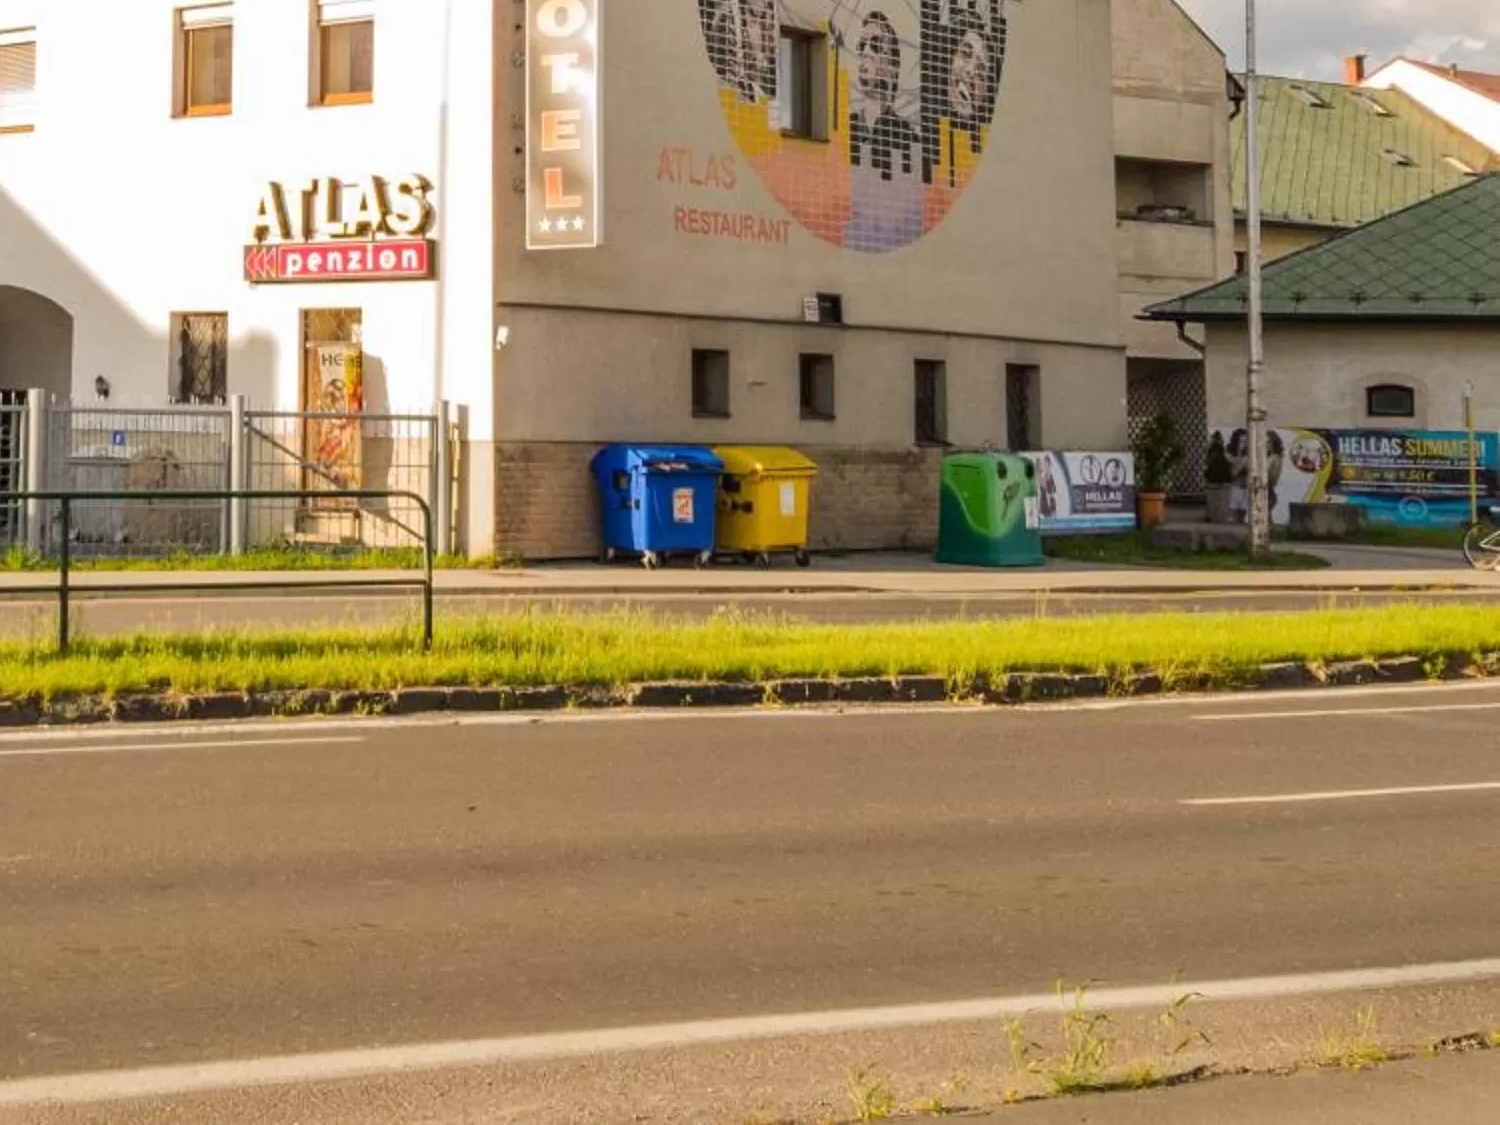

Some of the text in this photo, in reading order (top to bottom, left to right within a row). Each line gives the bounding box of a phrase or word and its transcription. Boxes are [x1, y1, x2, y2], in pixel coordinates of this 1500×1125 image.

[657, 146, 737, 191] ATLAS
[252, 174, 437, 242] ATLAS
[674, 205, 792, 246] RESTAURANT
[285, 244, 419, 278] penzion
[1338, 437, 1402, 456] HELLAS
